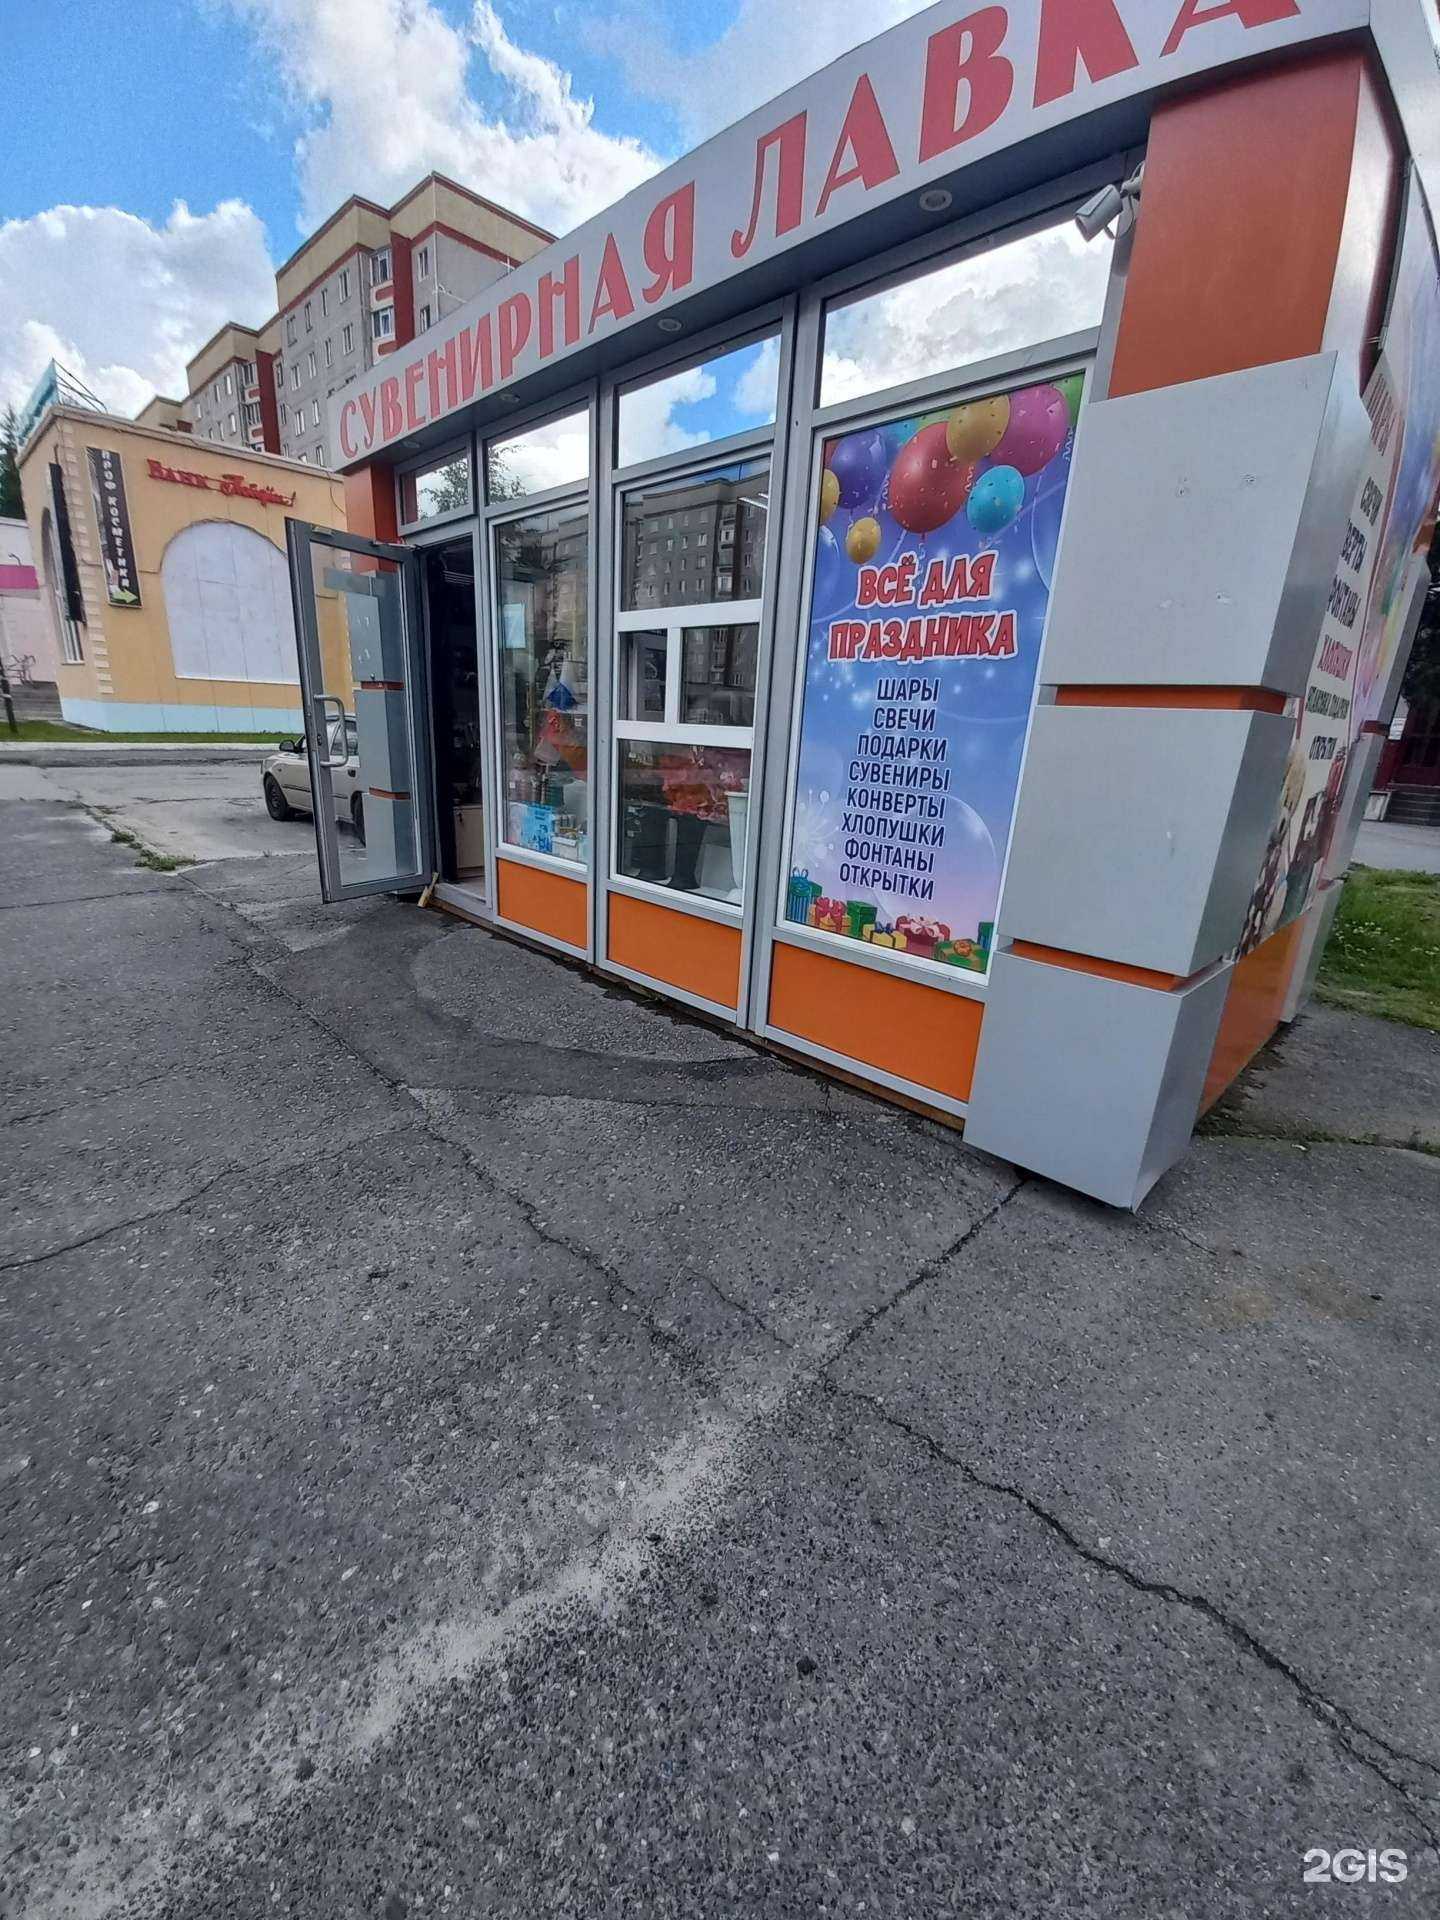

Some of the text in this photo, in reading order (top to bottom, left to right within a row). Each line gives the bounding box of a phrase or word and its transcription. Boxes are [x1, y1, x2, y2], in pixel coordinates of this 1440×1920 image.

[339, 180, 696, 458] СУВЕНИРНАЯ
[856, 551, 998, 608] ВСЁ ДЛЯ
[828, 611, 1016, 664] ПРАЗДНИКА
[876, 678, 939, 702] ШАРЫ
[873, 706, 936, 731] СВЕЧИ
[857, 734, 947, 762] ПОДАРКИ
[849, 760, 950, 791] СУВЕНИРЫ
[846, 787, 946, 819] КОНВЕРТЫ
[841, 812, 945, 847] ХЛОПУШКИ
[844, 838, 935, 874] ФОНТАНЫ
[839, 863, 935, 901] ОТКРЫТКИ
